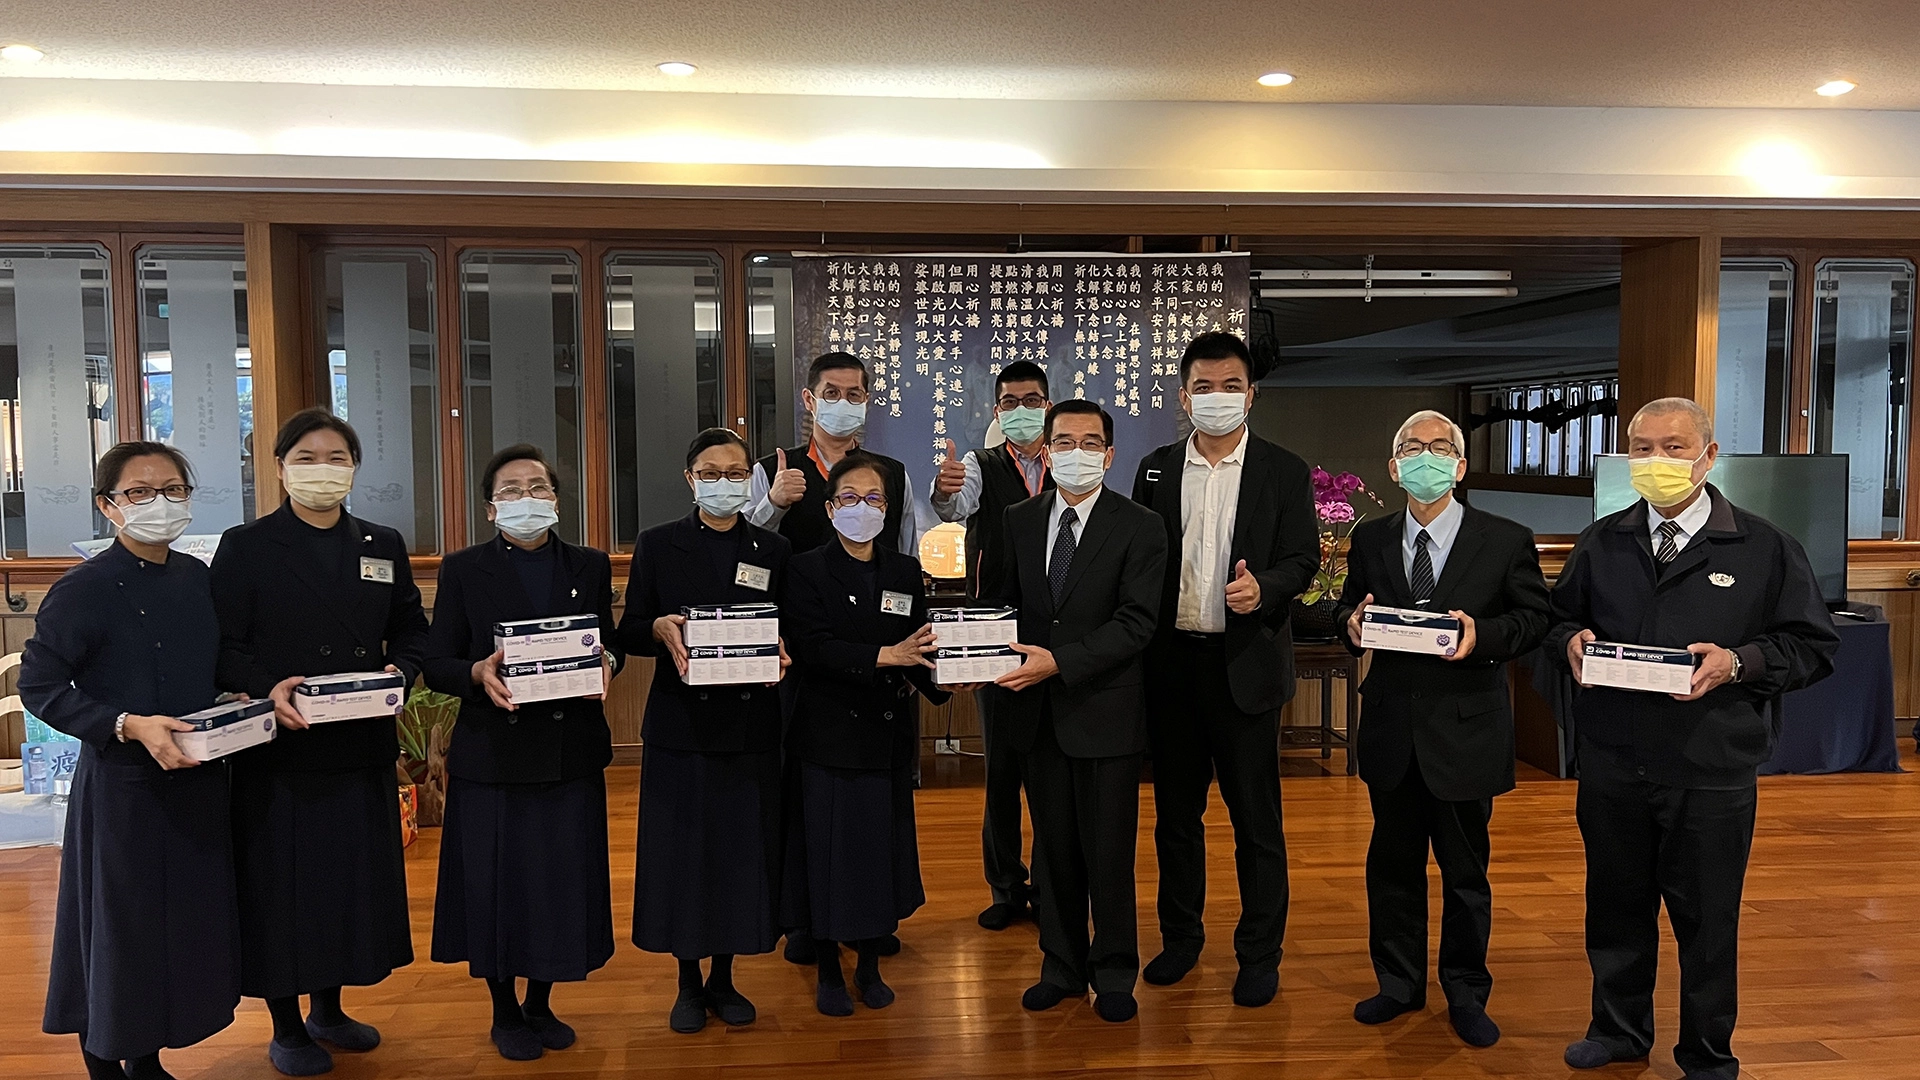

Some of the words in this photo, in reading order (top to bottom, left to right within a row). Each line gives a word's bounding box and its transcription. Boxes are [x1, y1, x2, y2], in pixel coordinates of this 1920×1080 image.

[858, 262, 872, 359] 大家心口一念
[888, 262, 901, 308] 我的心
[914, 263, 930, 376] 娑婆世界現光明
[965, 264, 981, 328] 用心祈禱
[1005, 264, 1018, 364] 點燃無窮清淨
[1051, 264, 1065, 328] 用心祈禱
[1073, 264, 1086, 360] 祈求天下無災
[1101, 264, 1114, 360] 大家心口一念
[1129, 263, 1142, 309] 我的心
[1165, 263, 1179, 376] 從不同角落地點
[1210, 262, 1224, 308] 我的心
[948, 264, 964, 406] 但願人人牽手心連心
[1150, 263, 1164, 410] 祈求平安吉祥滿人間
[51, 750, 76, 778] 疫
